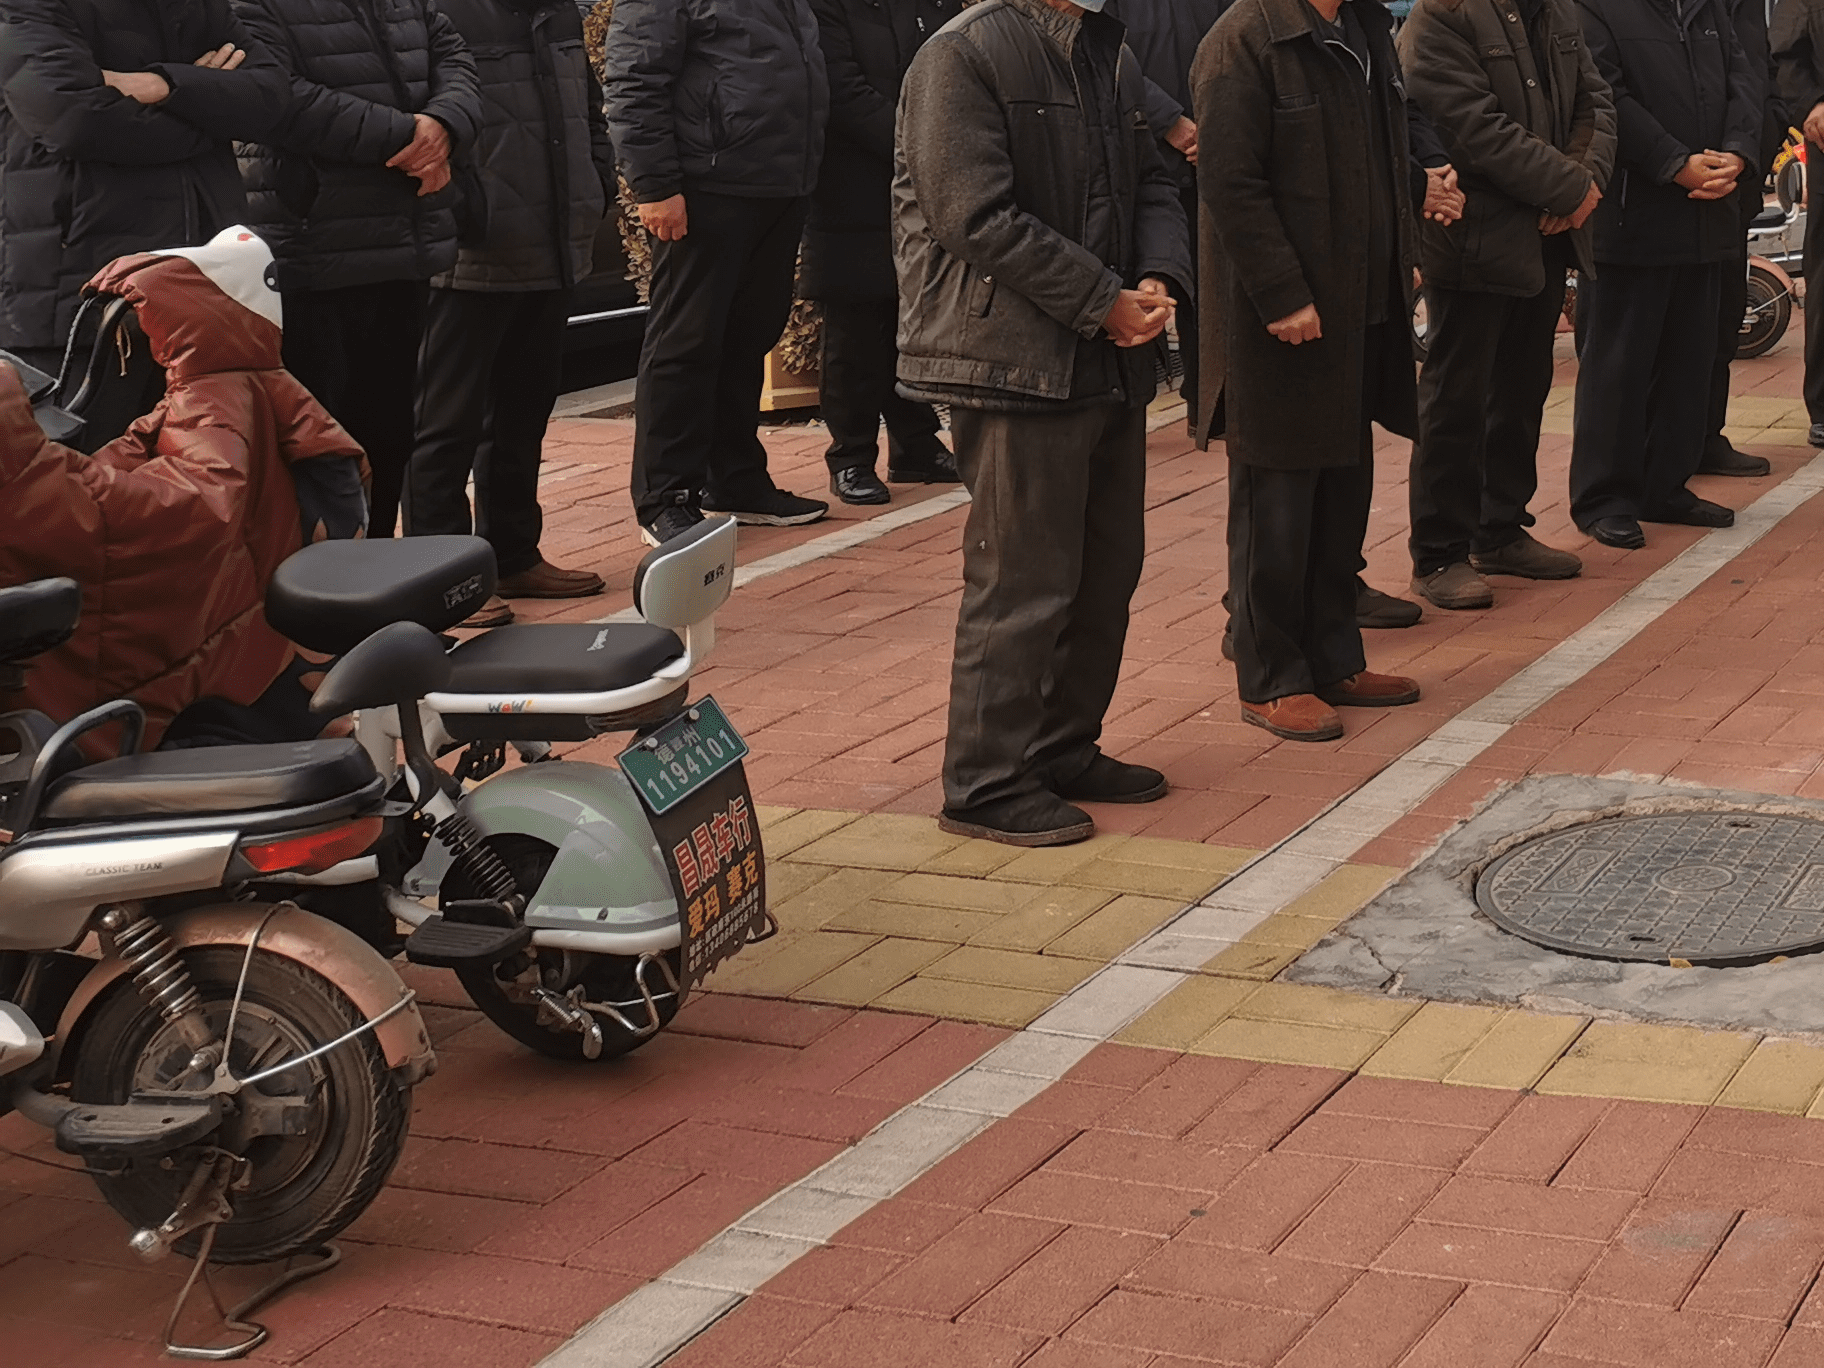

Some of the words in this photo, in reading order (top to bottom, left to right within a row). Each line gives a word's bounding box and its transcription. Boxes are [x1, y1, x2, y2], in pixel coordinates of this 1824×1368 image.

[647, 729, 736, 800] 1194101
[85, 866, 130, 877] CLASSIC
[134, 862, 163, 872] TEAM
[672, 795, 751, 899] 昌晟车行
[688, 884, 720, 938] 爱玛
